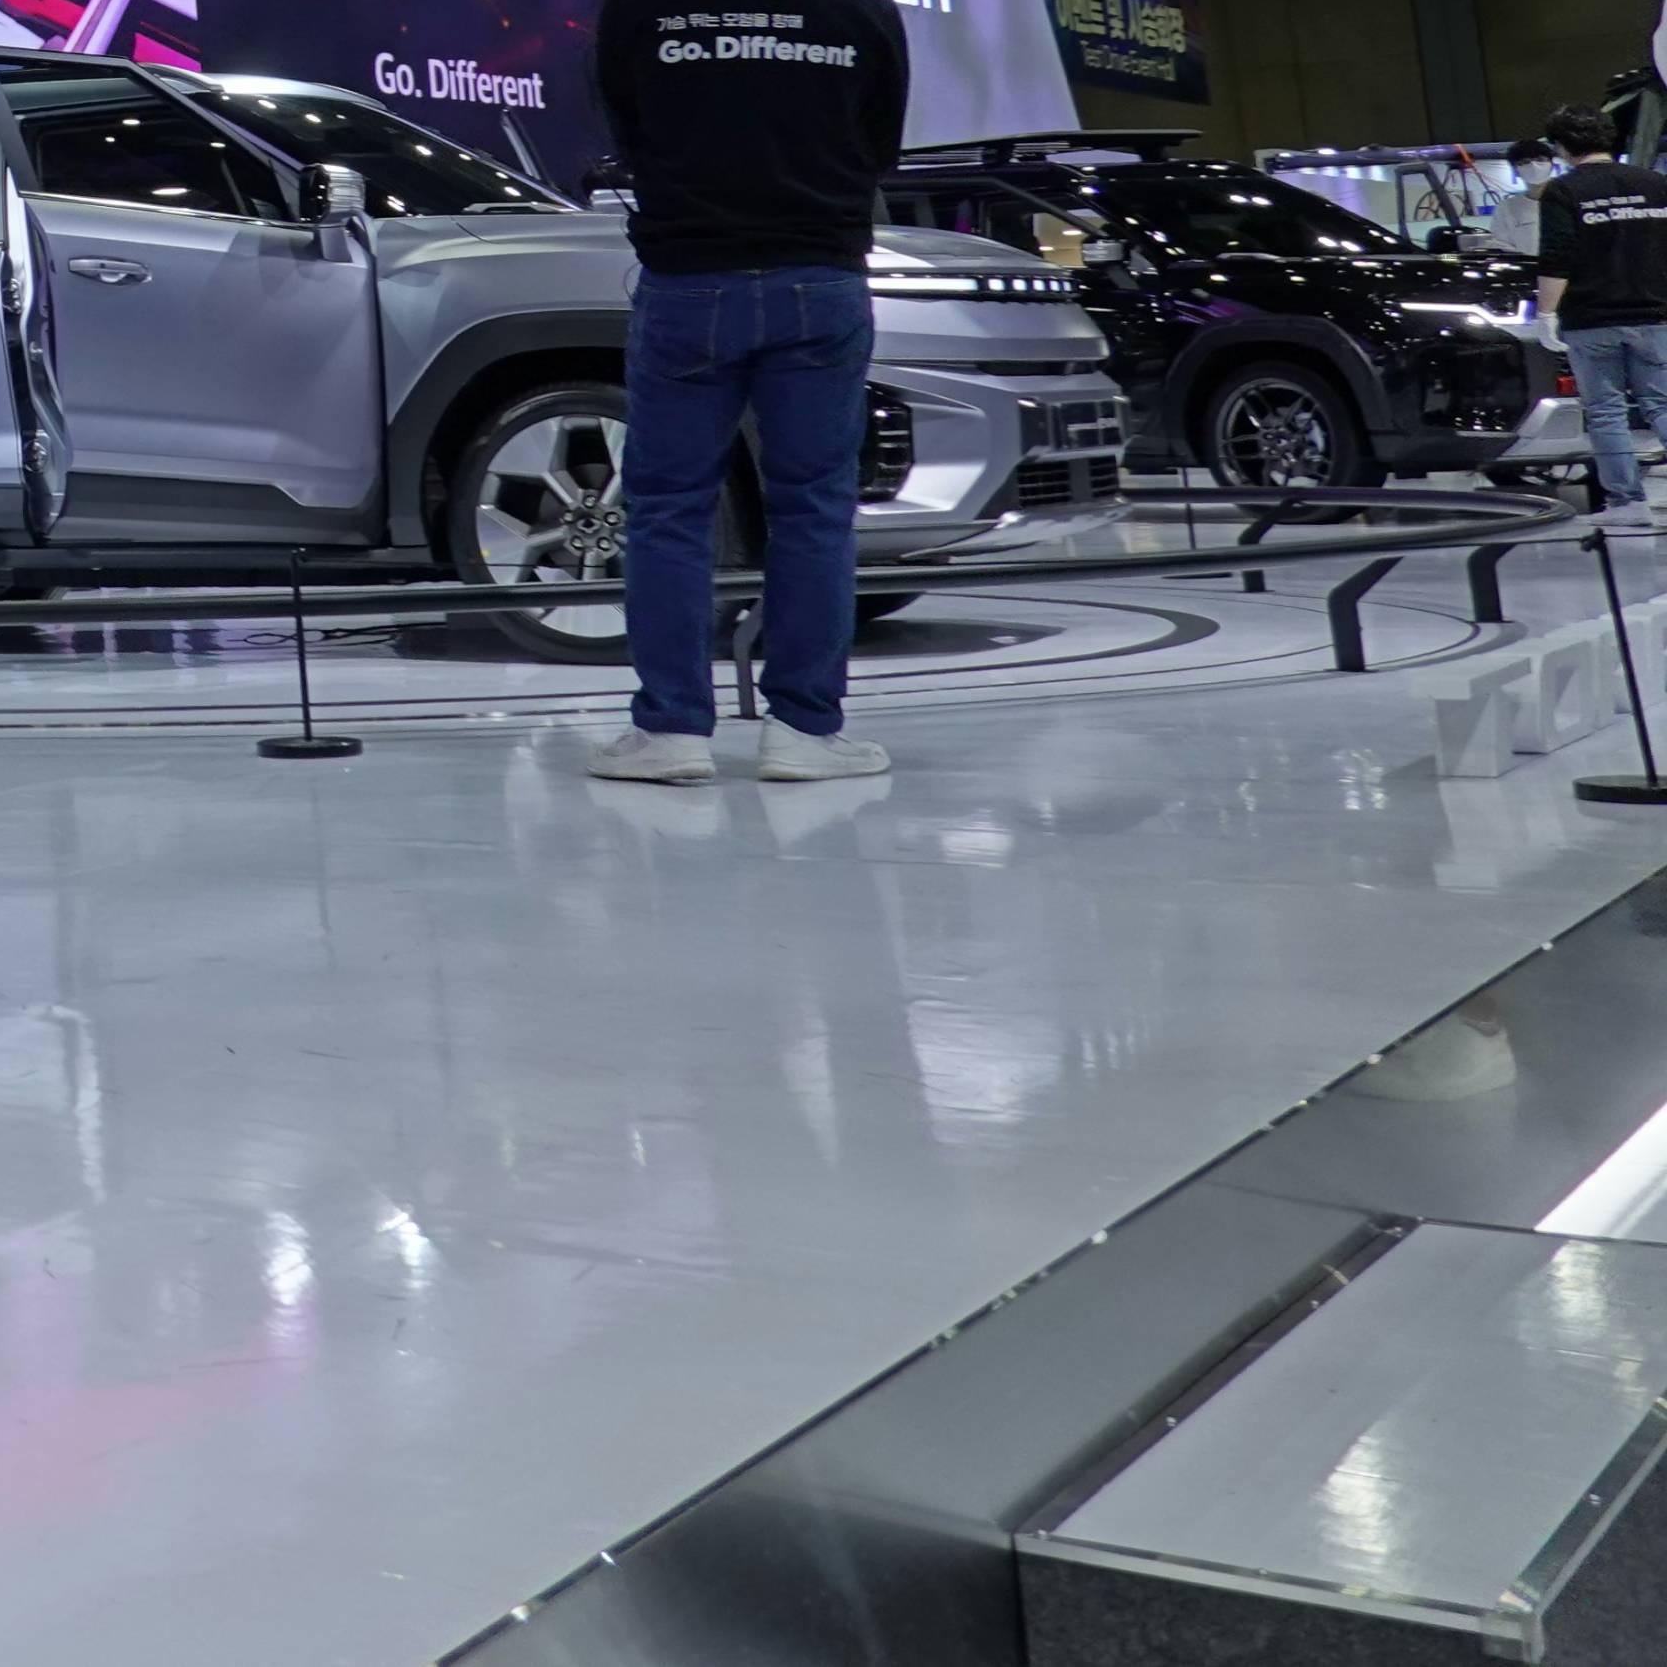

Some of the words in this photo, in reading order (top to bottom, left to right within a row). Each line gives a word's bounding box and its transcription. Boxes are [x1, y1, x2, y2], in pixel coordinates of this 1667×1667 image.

[658, 40, 712, 63] Go.
[715, 36, 857, 67] Different
[375, 52, 423, 98] Go.
[427, 58, 546, 109] Different
